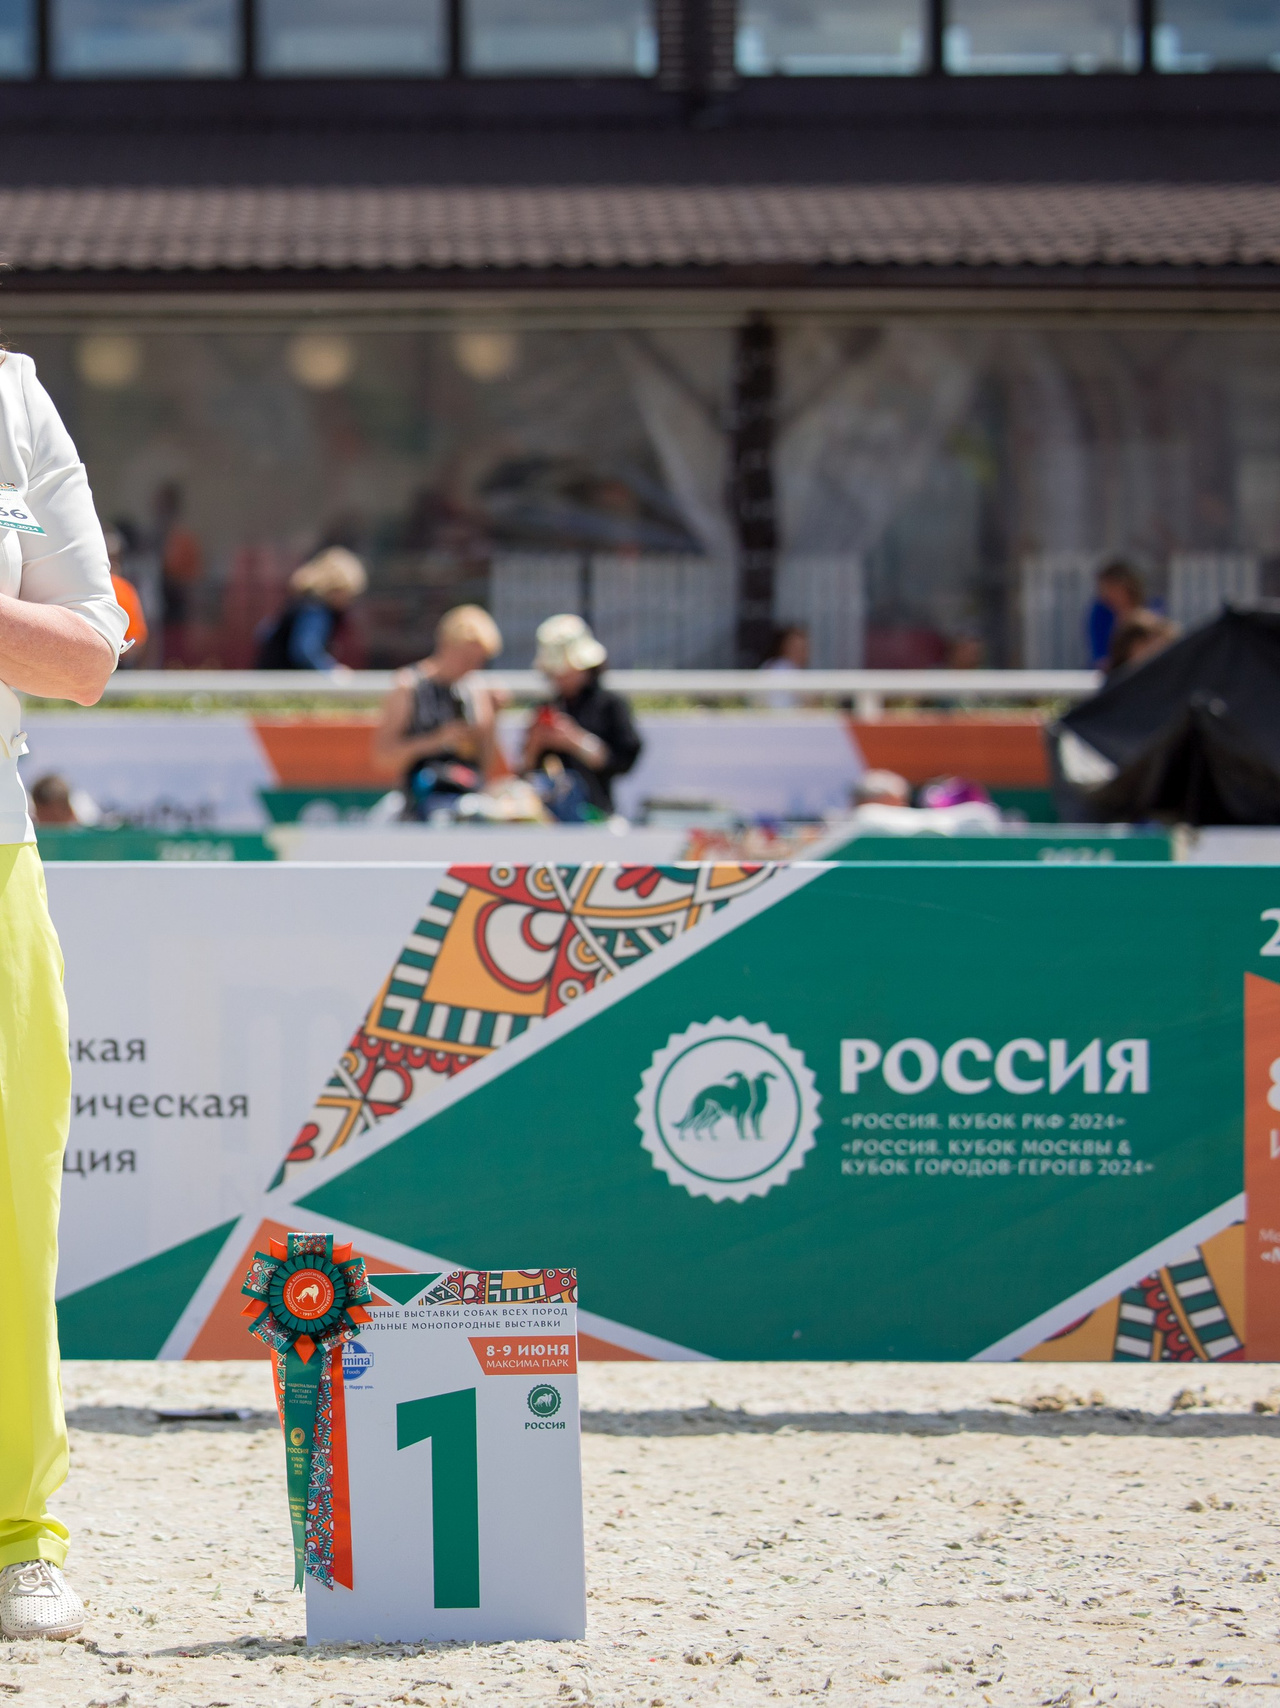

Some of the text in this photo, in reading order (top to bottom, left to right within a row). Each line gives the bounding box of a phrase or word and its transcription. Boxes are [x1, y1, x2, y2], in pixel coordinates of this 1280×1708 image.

[840, 1037, 1149, 1095] РОССИЯ
[948, 1112, 1017, 1130] КУБОК
[1022, 1112, 1065, 1130] РКФ
[948, 1138, 1017, 1156] КУБОК
[1021, 1138, 1113, 1156] МОСКВЫ
[1117, 1139, 1132, 1156] &
[841, 1158, 909, 1176] КУБОК
[404, 1309, 460, 1318] ВЫСТАВКИ
[463, 1309, 498, 1317] СОБАК
[502, 1308, 528, 1316] ВСЕХ
[532, 1308, 568, 1316] ПОРОД
[411, 1321, 501, 1330] МОНОПОРОДНЫЕ
[505, 1320, 561, 1328] ВЫСТАВКИ
[486, 1344, 570, 1357] 8-9 ИЮНЯ
[486, 1358, 569, 1369] МАКСИМА ПАРК
[524, 1421, 566, 1430] РОССИЯ
[396, 1387, 481, 1609] 1
